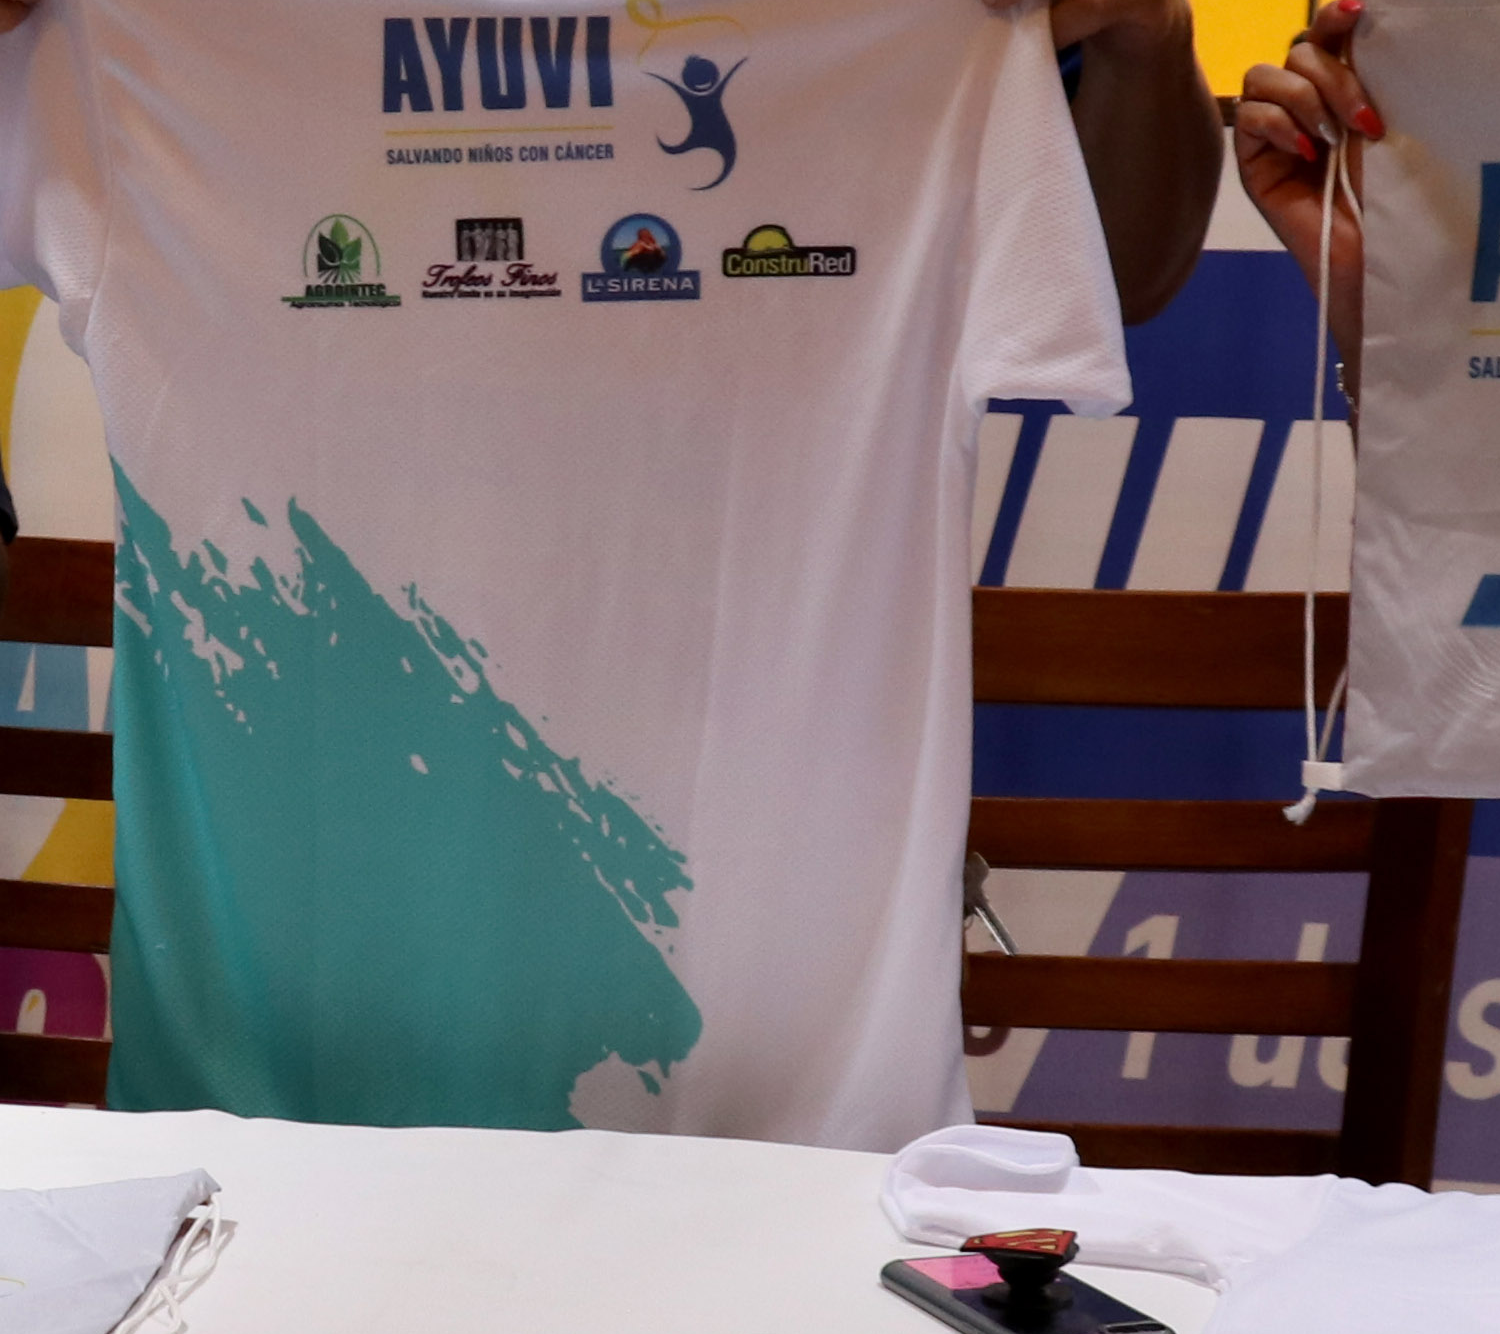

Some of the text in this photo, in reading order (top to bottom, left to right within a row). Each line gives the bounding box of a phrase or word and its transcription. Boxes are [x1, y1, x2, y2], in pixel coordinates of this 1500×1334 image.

[382, 16, 614, 113] AYUVI
[386, 140, 615, 165] SALVANDO NIÑOS CON CÁNCER
[726, 252, 852, 276] ConstruRed
[607, 276, 696, 294] SIRENA
